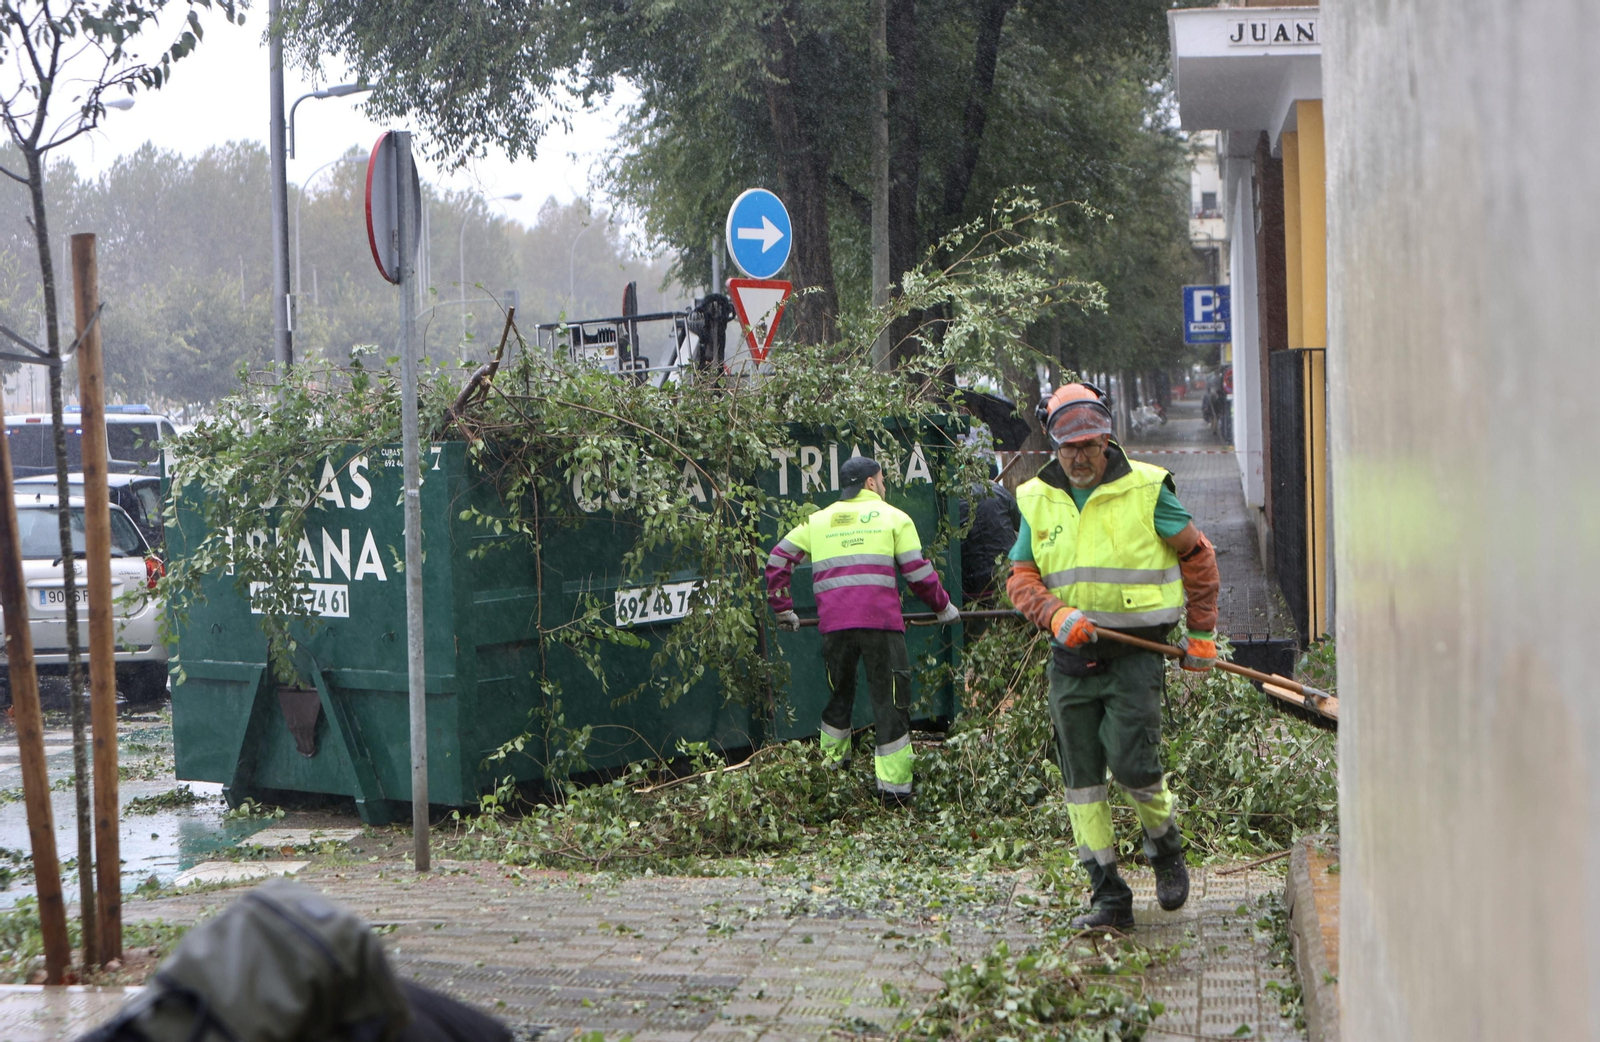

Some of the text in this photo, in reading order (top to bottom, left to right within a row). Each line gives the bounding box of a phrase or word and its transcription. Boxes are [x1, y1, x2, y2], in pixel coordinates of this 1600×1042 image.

[1230, 23, 1314, 42] JUAN
[1193, 290, 1221, 322] P
[331, 591, 347, 613] 61
[618, 597, 648, 620] 692
